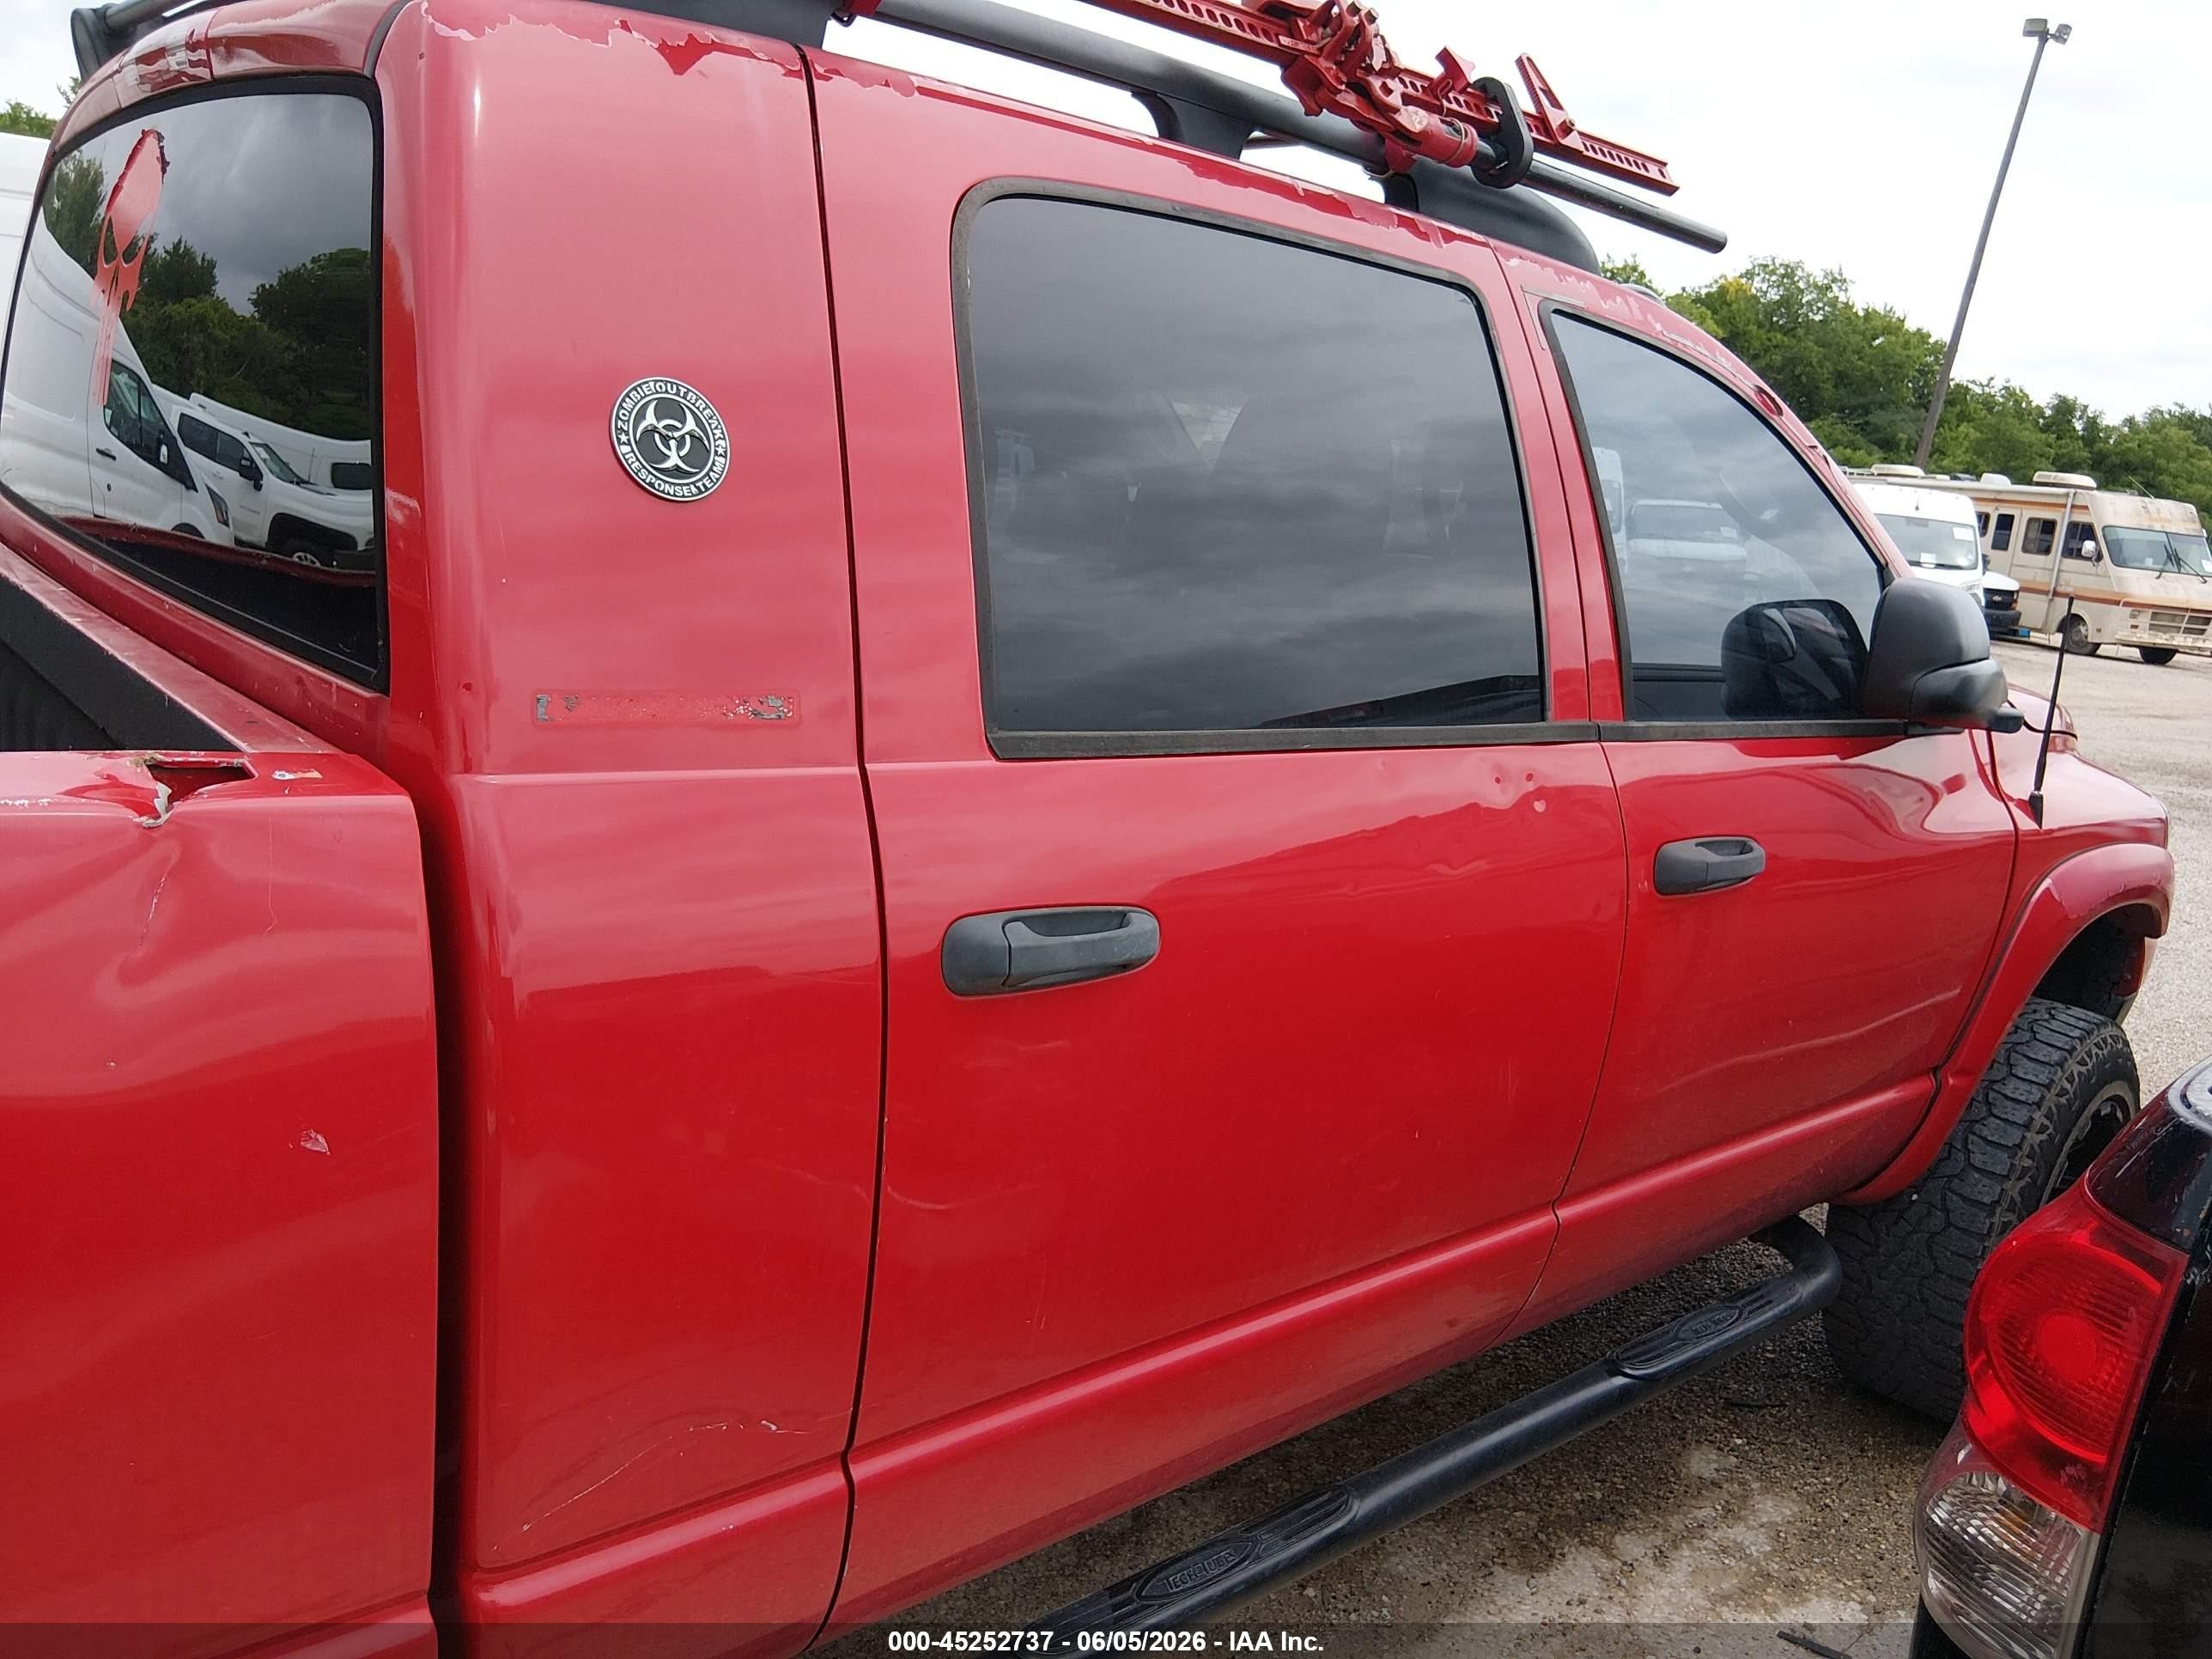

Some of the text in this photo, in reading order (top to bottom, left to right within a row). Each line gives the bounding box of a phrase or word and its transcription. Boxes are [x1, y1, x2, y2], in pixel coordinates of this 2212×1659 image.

[617, 381, 724, 440] ZOMBIE OUTBREAK
[625, 453, 726, 497] RESPONSE TEAM
